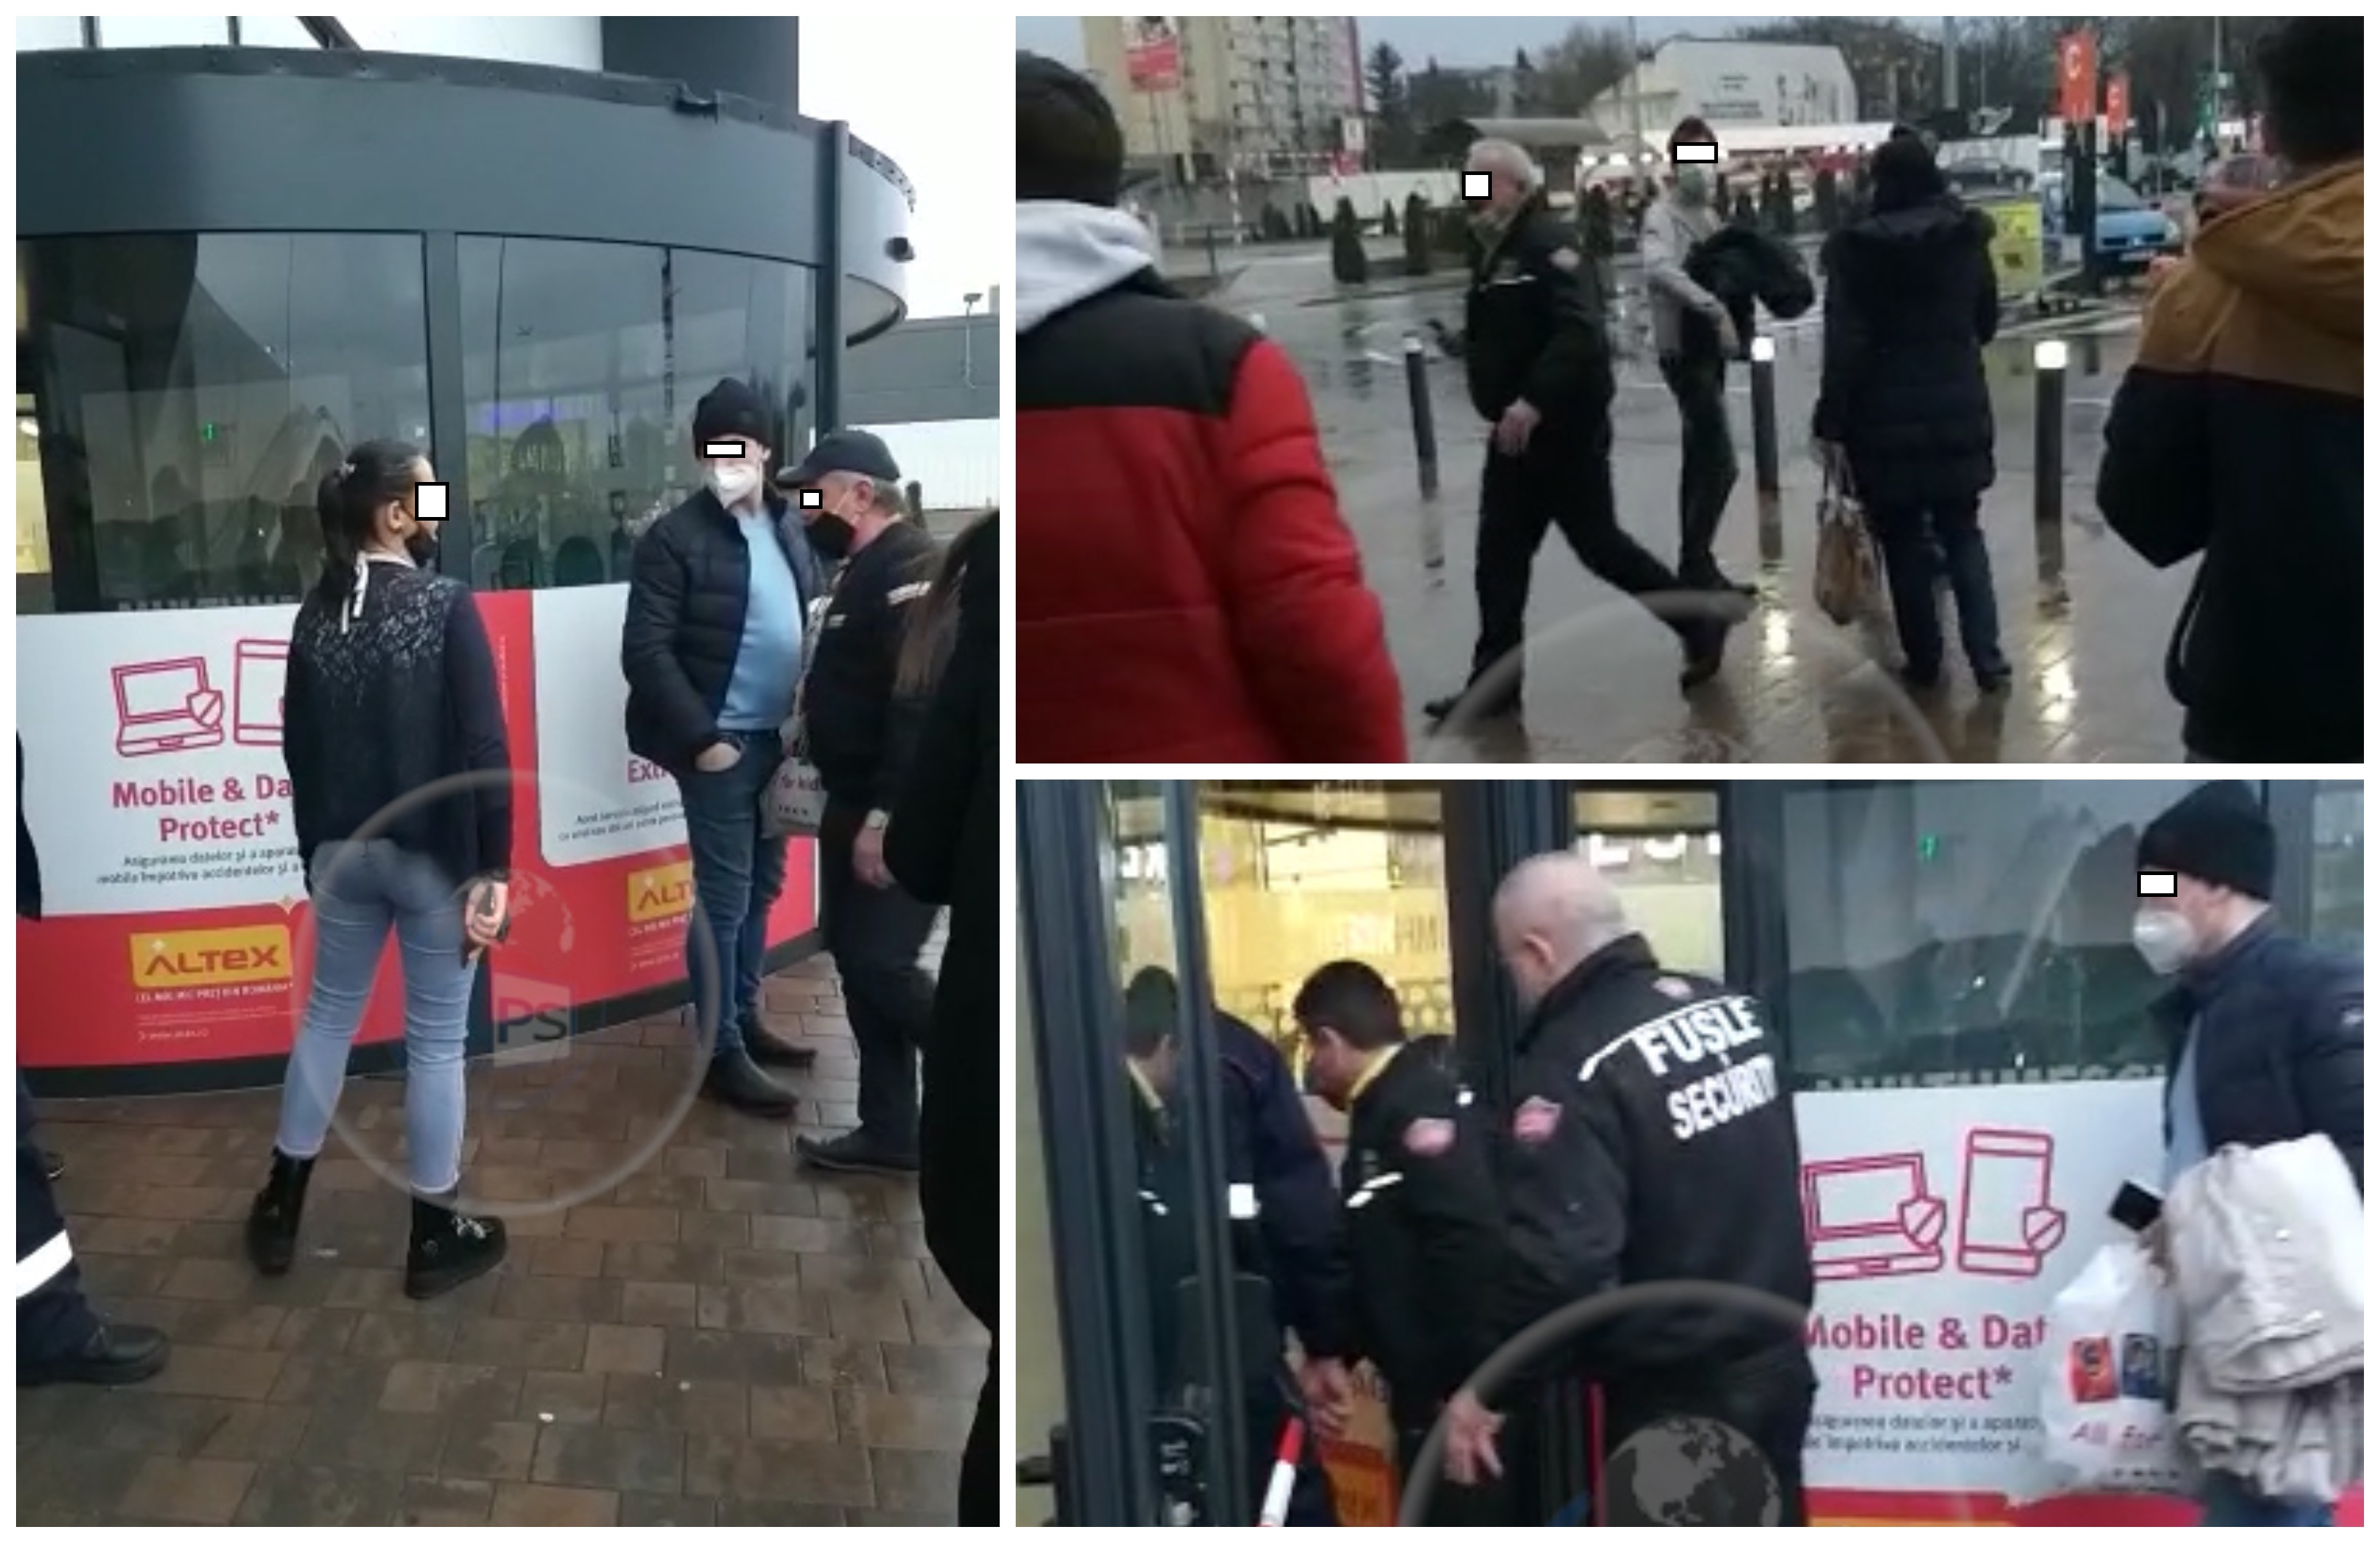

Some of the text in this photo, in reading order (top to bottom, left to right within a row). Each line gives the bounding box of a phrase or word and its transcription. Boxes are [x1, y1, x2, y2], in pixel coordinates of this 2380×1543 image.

[112, 774, 293, 808] Mobile & Da
[1804, 1313, 1926, 1350] Mobile
[1939, 1317, 1969, 1350] &
